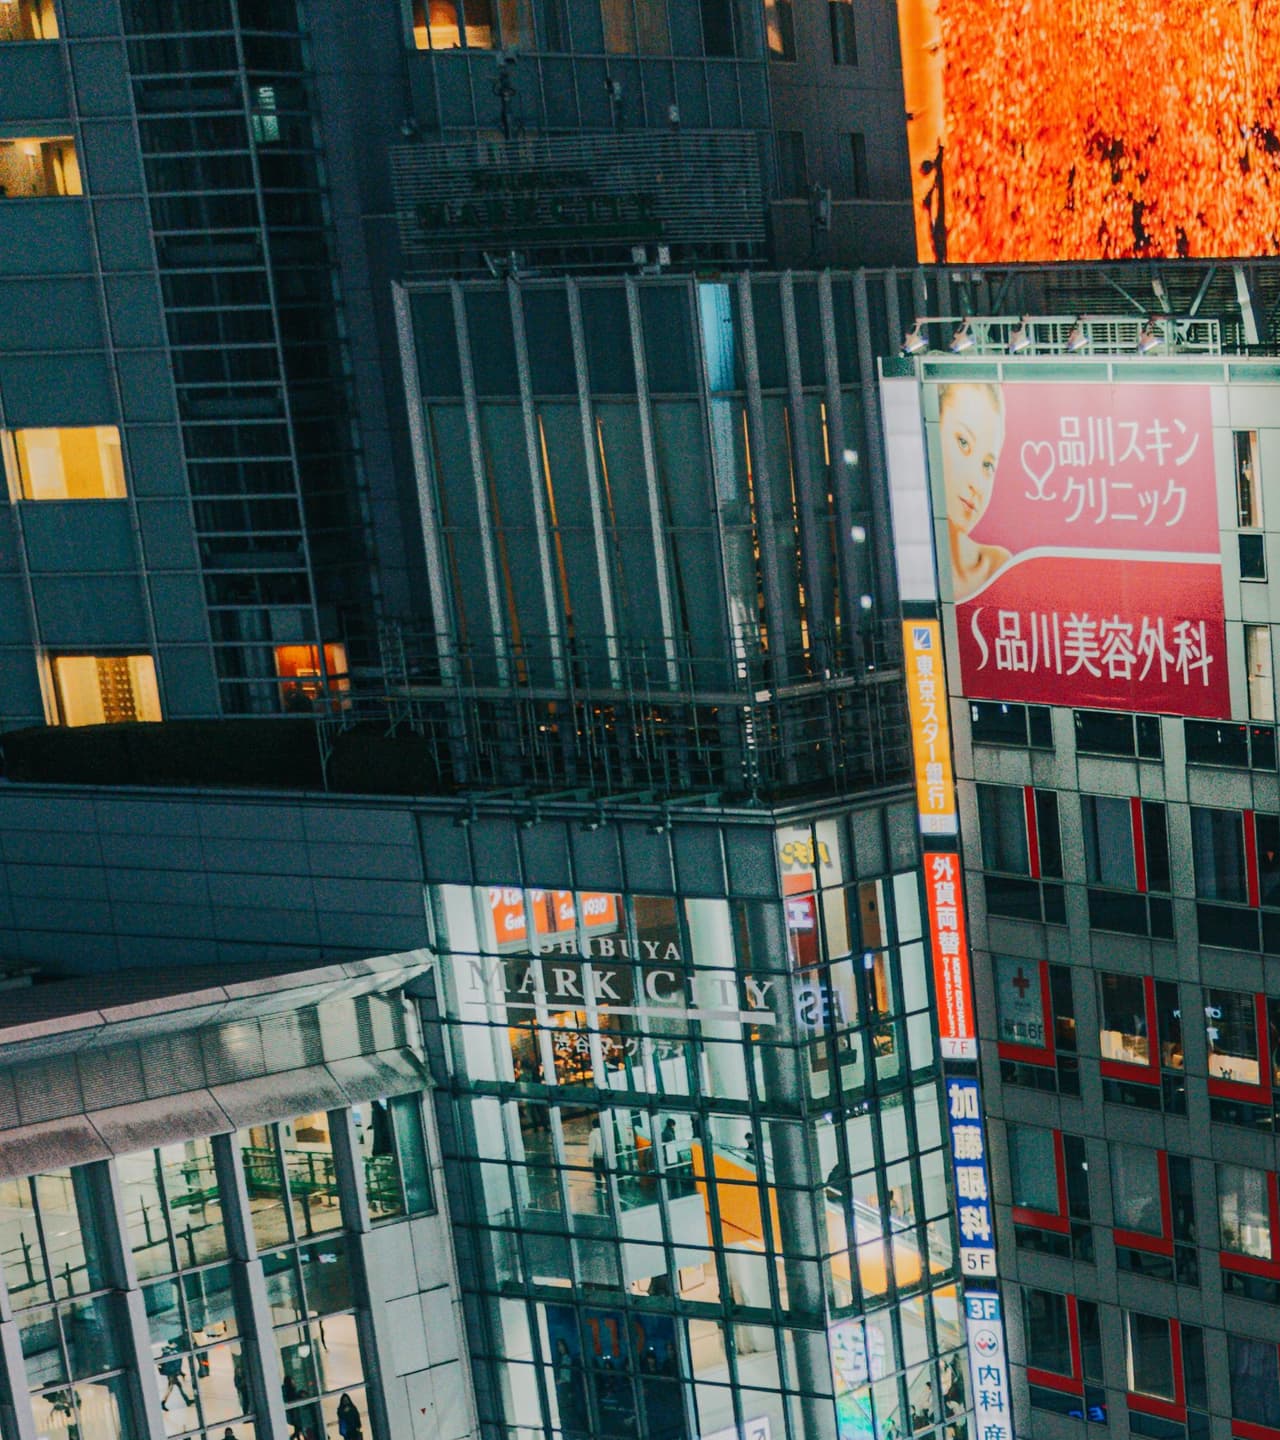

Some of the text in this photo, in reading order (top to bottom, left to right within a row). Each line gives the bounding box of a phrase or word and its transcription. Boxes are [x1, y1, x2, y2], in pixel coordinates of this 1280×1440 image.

[1057, 415, 1200, 467] 品川スキン
[1062, 477, 1188, 527] クリニック
[995, 609, 1214, 687] 品川美容外科
[914, 654, 945, 809] 東京スター銀行
[932, 856, 960, 955] 外貨両替
[538, 936, 682, 961] SHIBUYA
[468, 959, 775, 1011] MARK CITY
[966, 1253, 993, 1270] 5F
[969, 1299, 997, 1320] 3F
